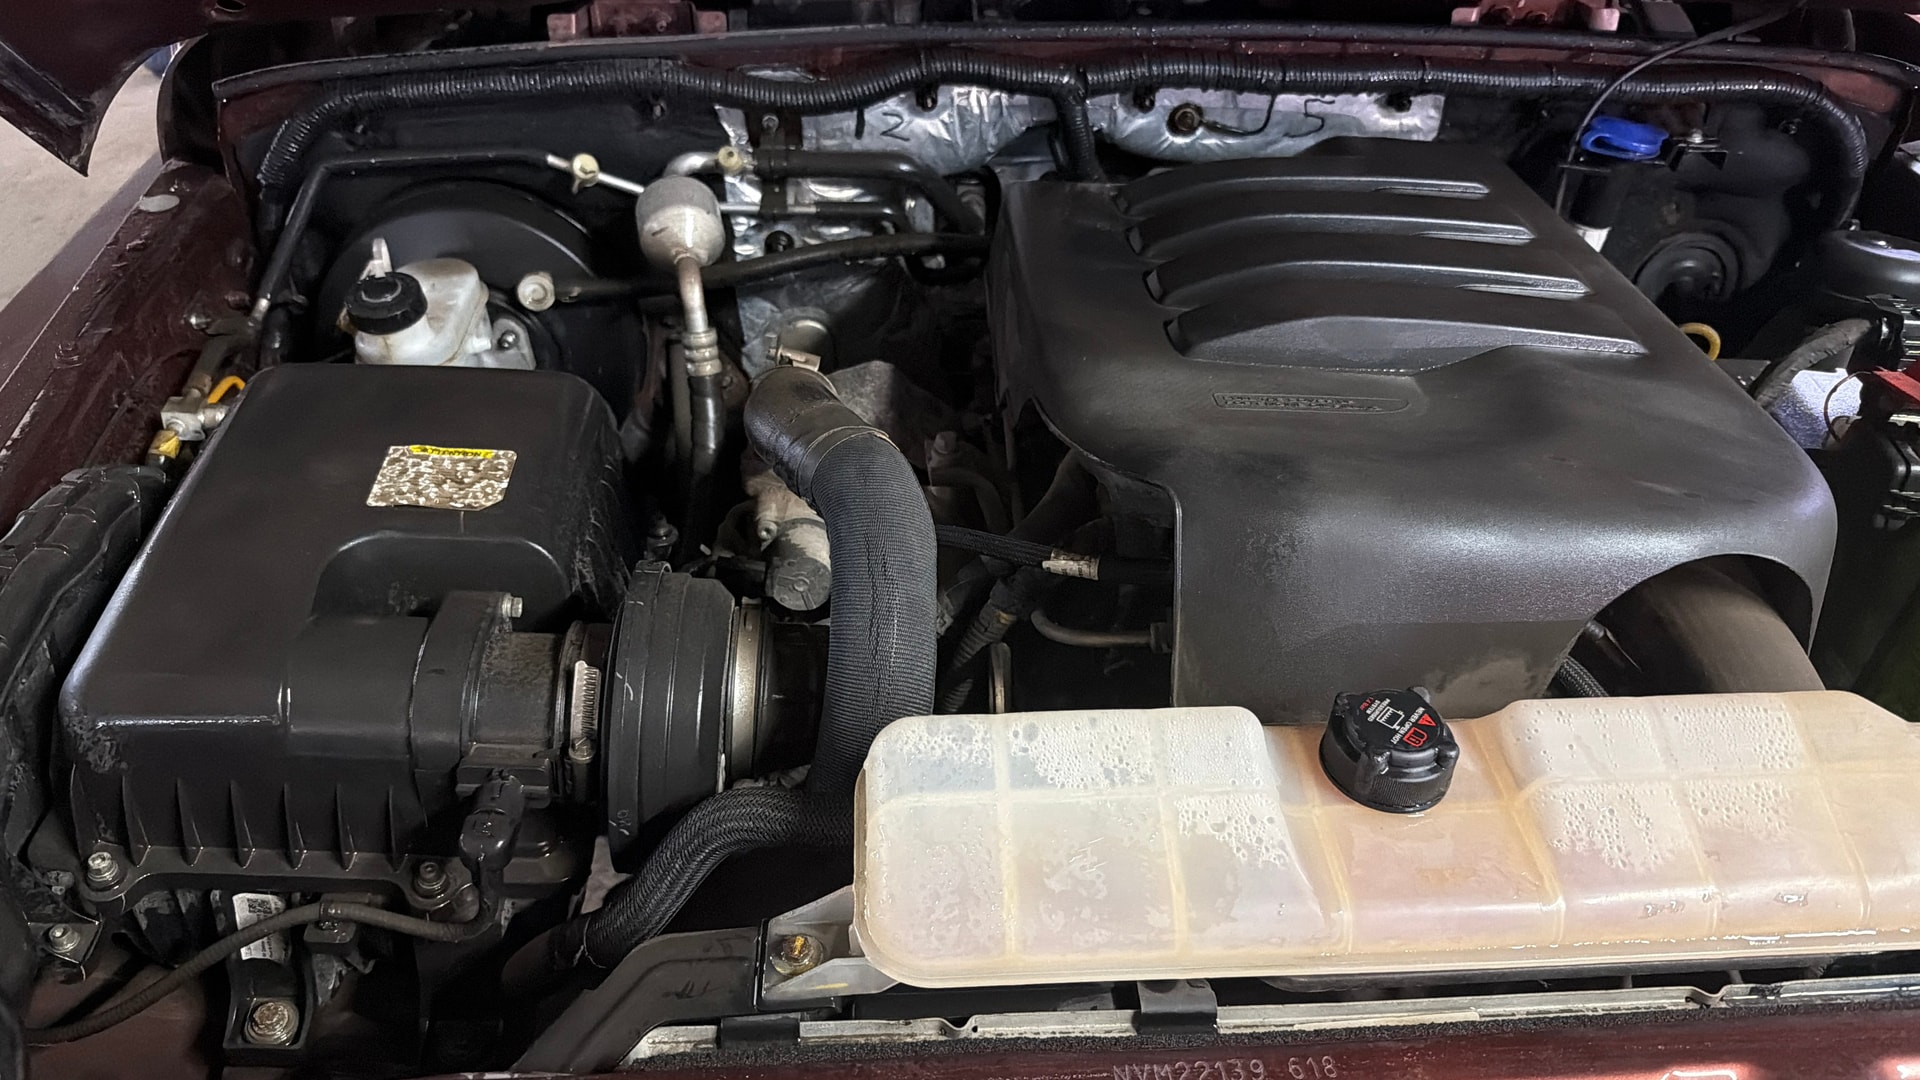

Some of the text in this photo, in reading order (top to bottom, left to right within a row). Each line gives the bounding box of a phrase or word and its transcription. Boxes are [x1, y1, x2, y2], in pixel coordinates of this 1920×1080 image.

[1366, 700, 1380, 714] SYSTEM
[1390, 707, 1425, 744] NEVER OPEN HOT
[1288, 1056, 1337, 1079] 618
